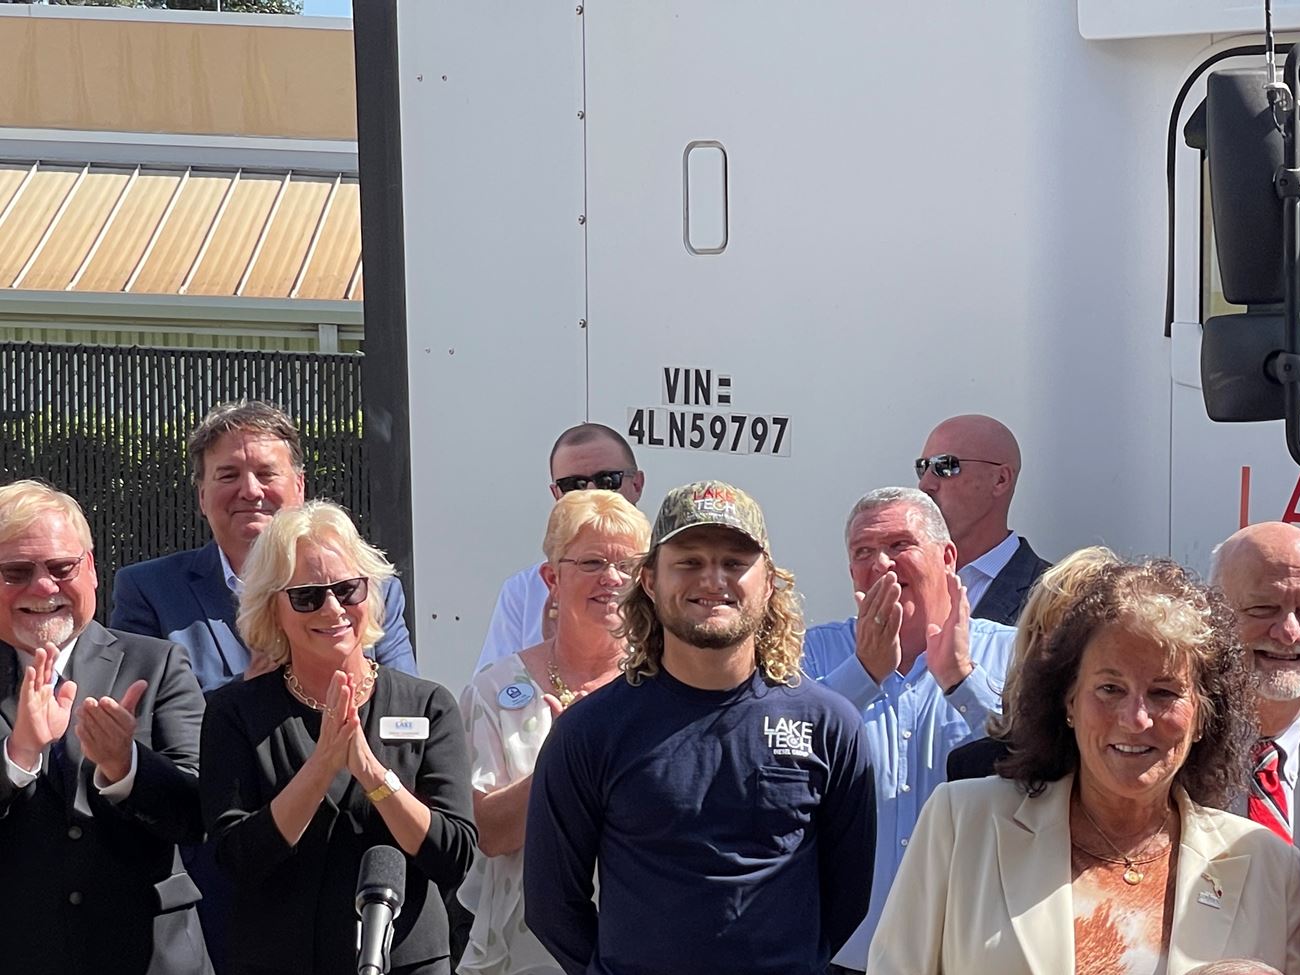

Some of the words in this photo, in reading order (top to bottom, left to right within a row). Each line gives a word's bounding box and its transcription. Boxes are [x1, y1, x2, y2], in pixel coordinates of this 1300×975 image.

[628, 409, 789, 454] 4LN59797
[693, 485, 736, 502] LAKE
[694, 499, 736, 515] TECH
[764, 716, 814, 739] LAKE
[764, 731, 813, 753] TECH
